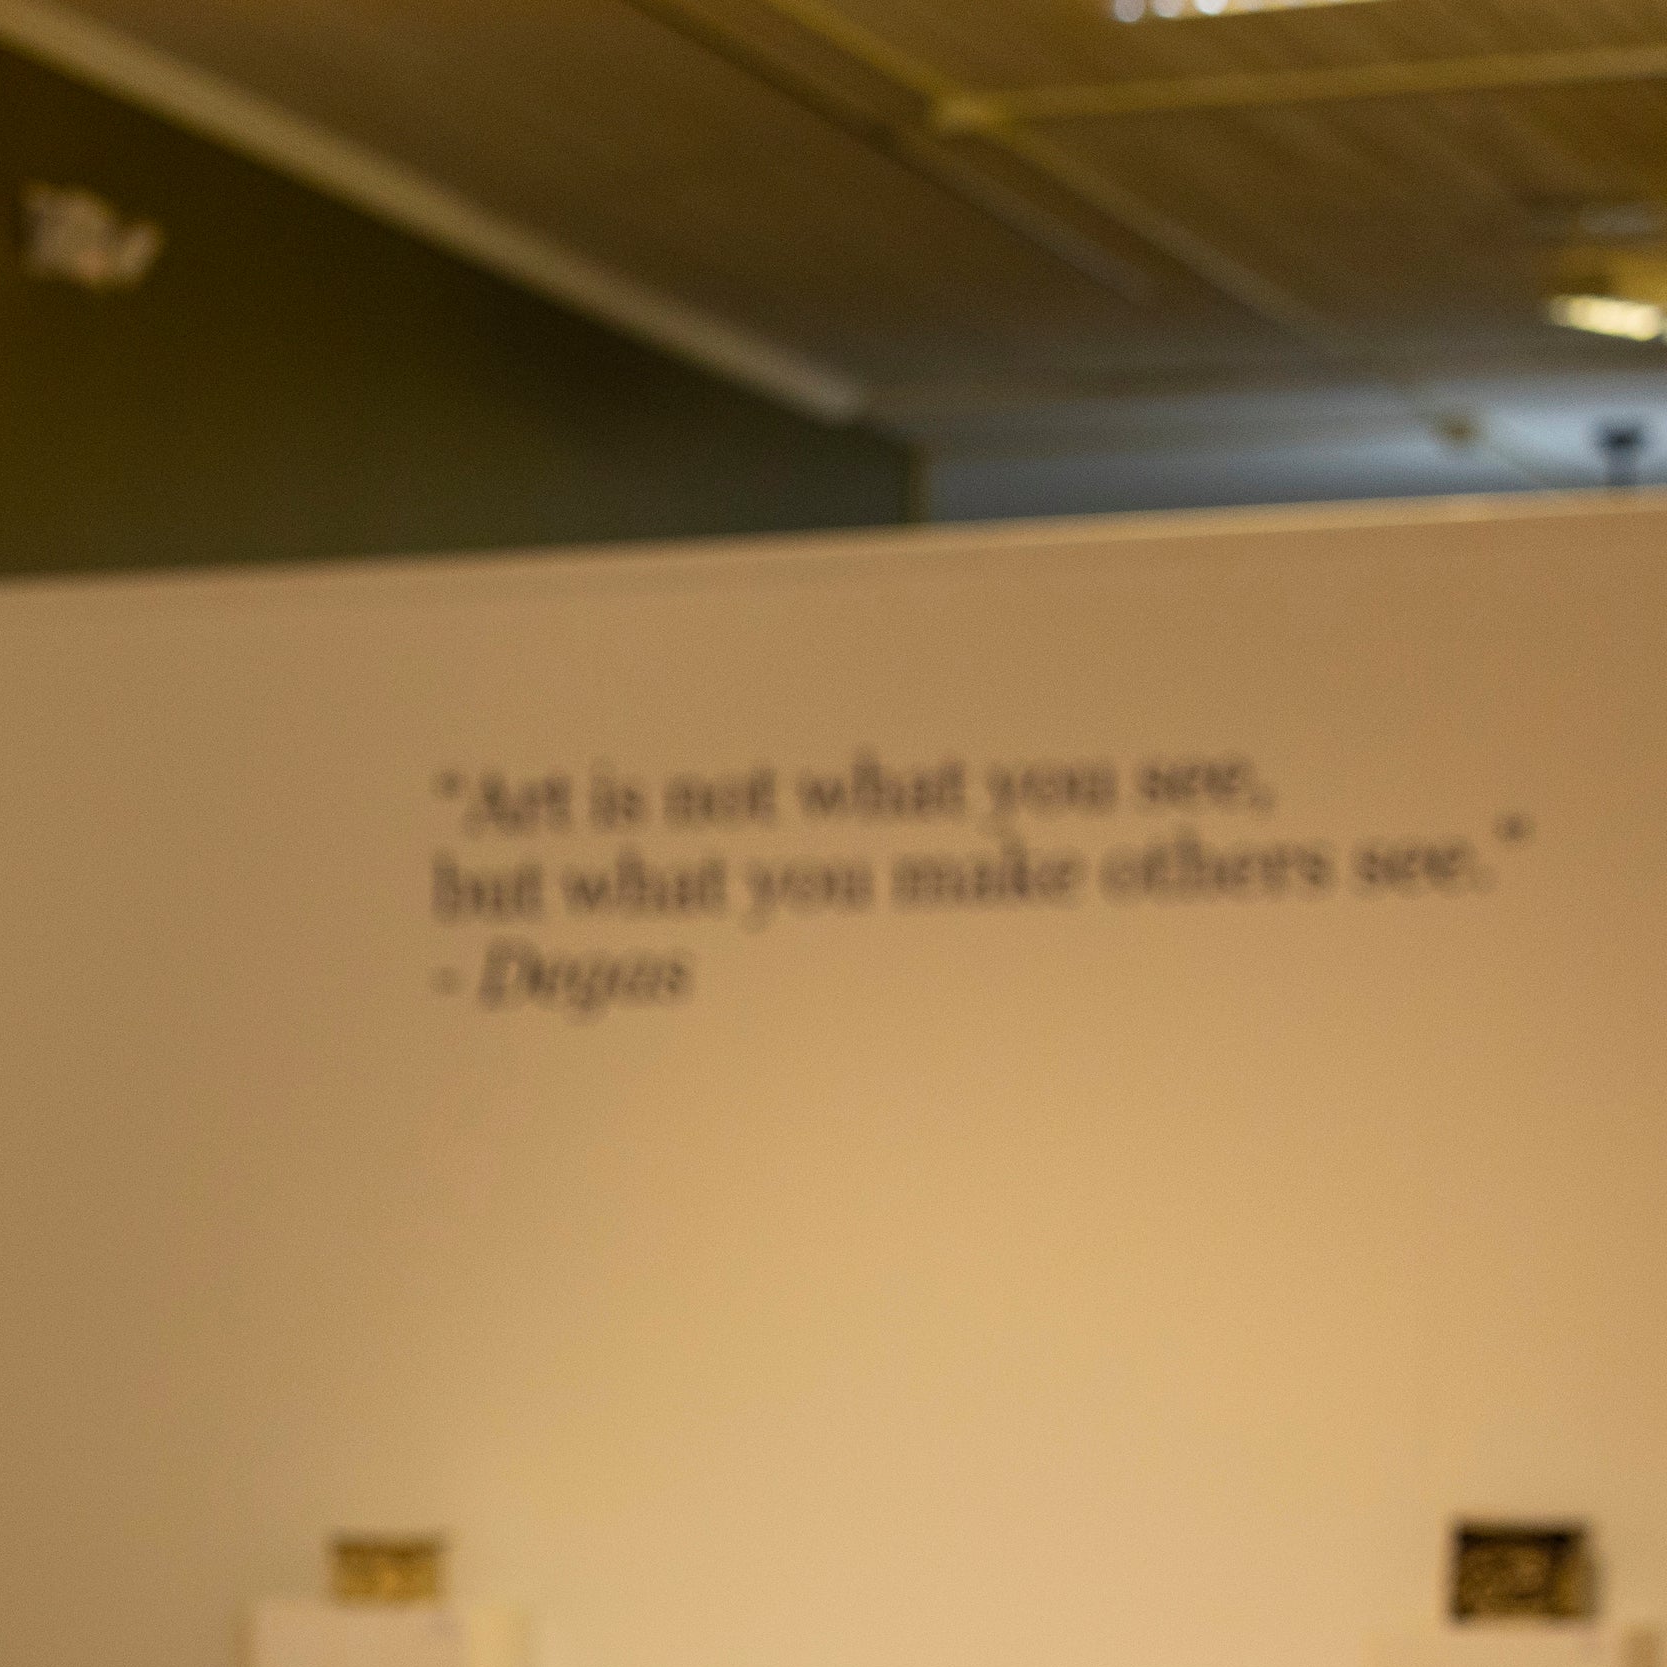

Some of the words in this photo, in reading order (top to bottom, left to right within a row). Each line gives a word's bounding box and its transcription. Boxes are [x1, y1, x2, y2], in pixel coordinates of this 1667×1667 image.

[589, 763, 647, 832] is
[664, 766, 777, 829] not
[799, 752, 967, 822] what
[983, 764, 1119, 836] you
[1135, 756, 1275, 812] see,
[431, 856, 547, 920] but
[561, 850, 727, 916] what
[745, 860, 875, 930] you
[889, 836, 1085, 908] make
[1101, 830, 1335, 904] others
[479, 938, 691, 1018] Degas
